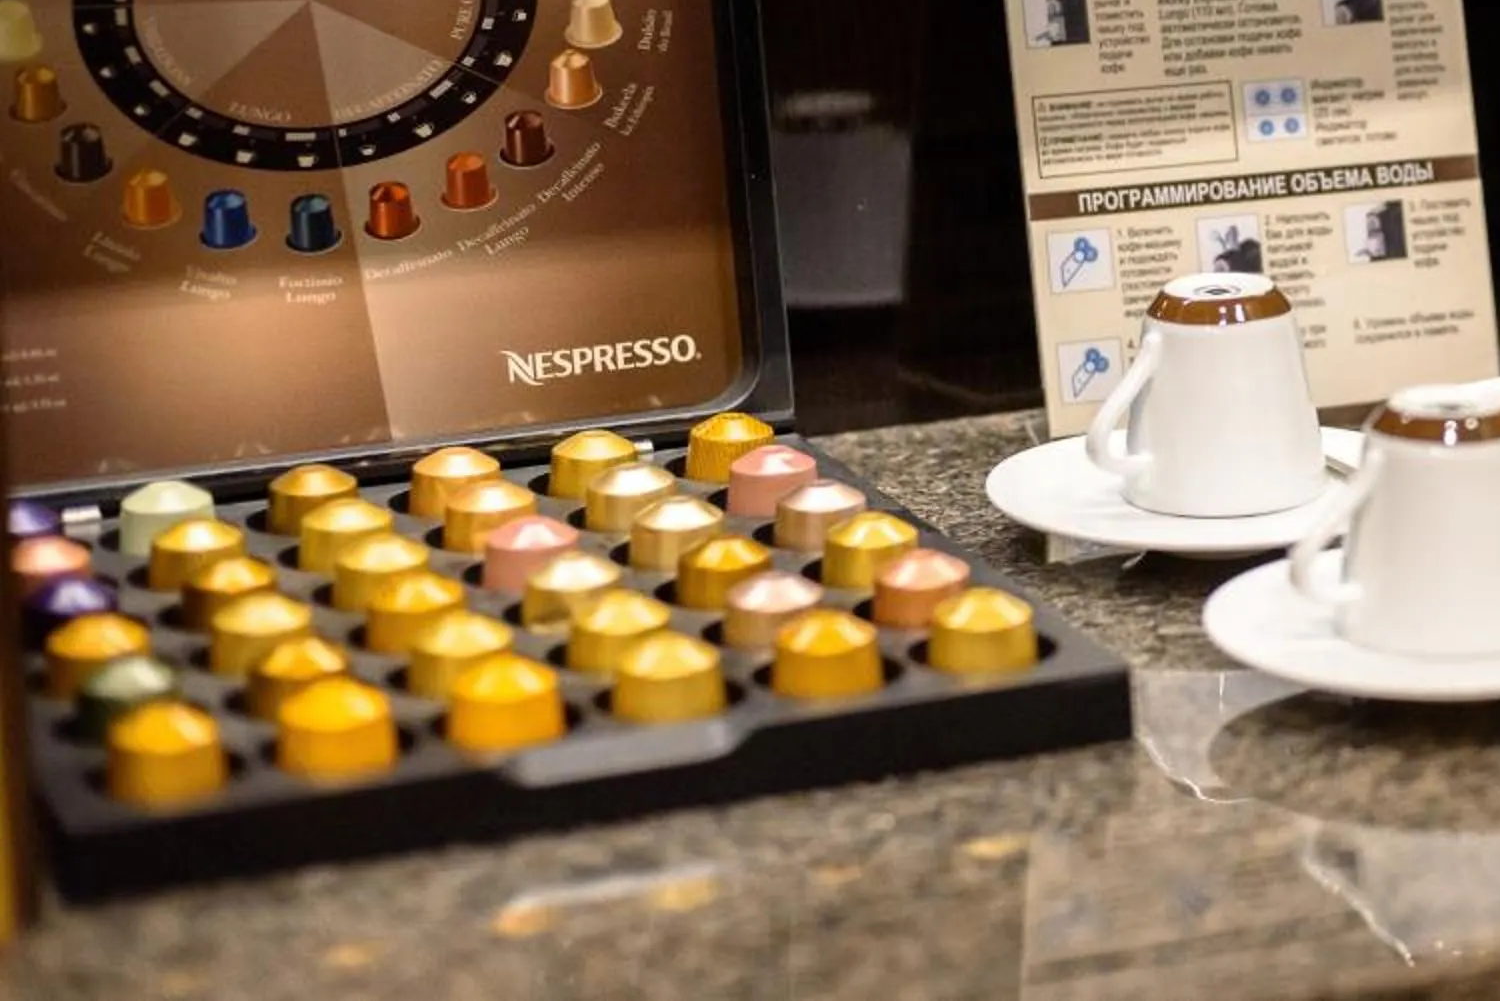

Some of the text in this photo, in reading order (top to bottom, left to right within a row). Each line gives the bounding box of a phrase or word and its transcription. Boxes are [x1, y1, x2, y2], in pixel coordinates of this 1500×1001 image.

[1078, 161, 1434, 214] ПРОГРАММИРОВАНИЕ ОБЪЕМА ВОДЫ
[501, 334, 697, 386] NESPRESSO
